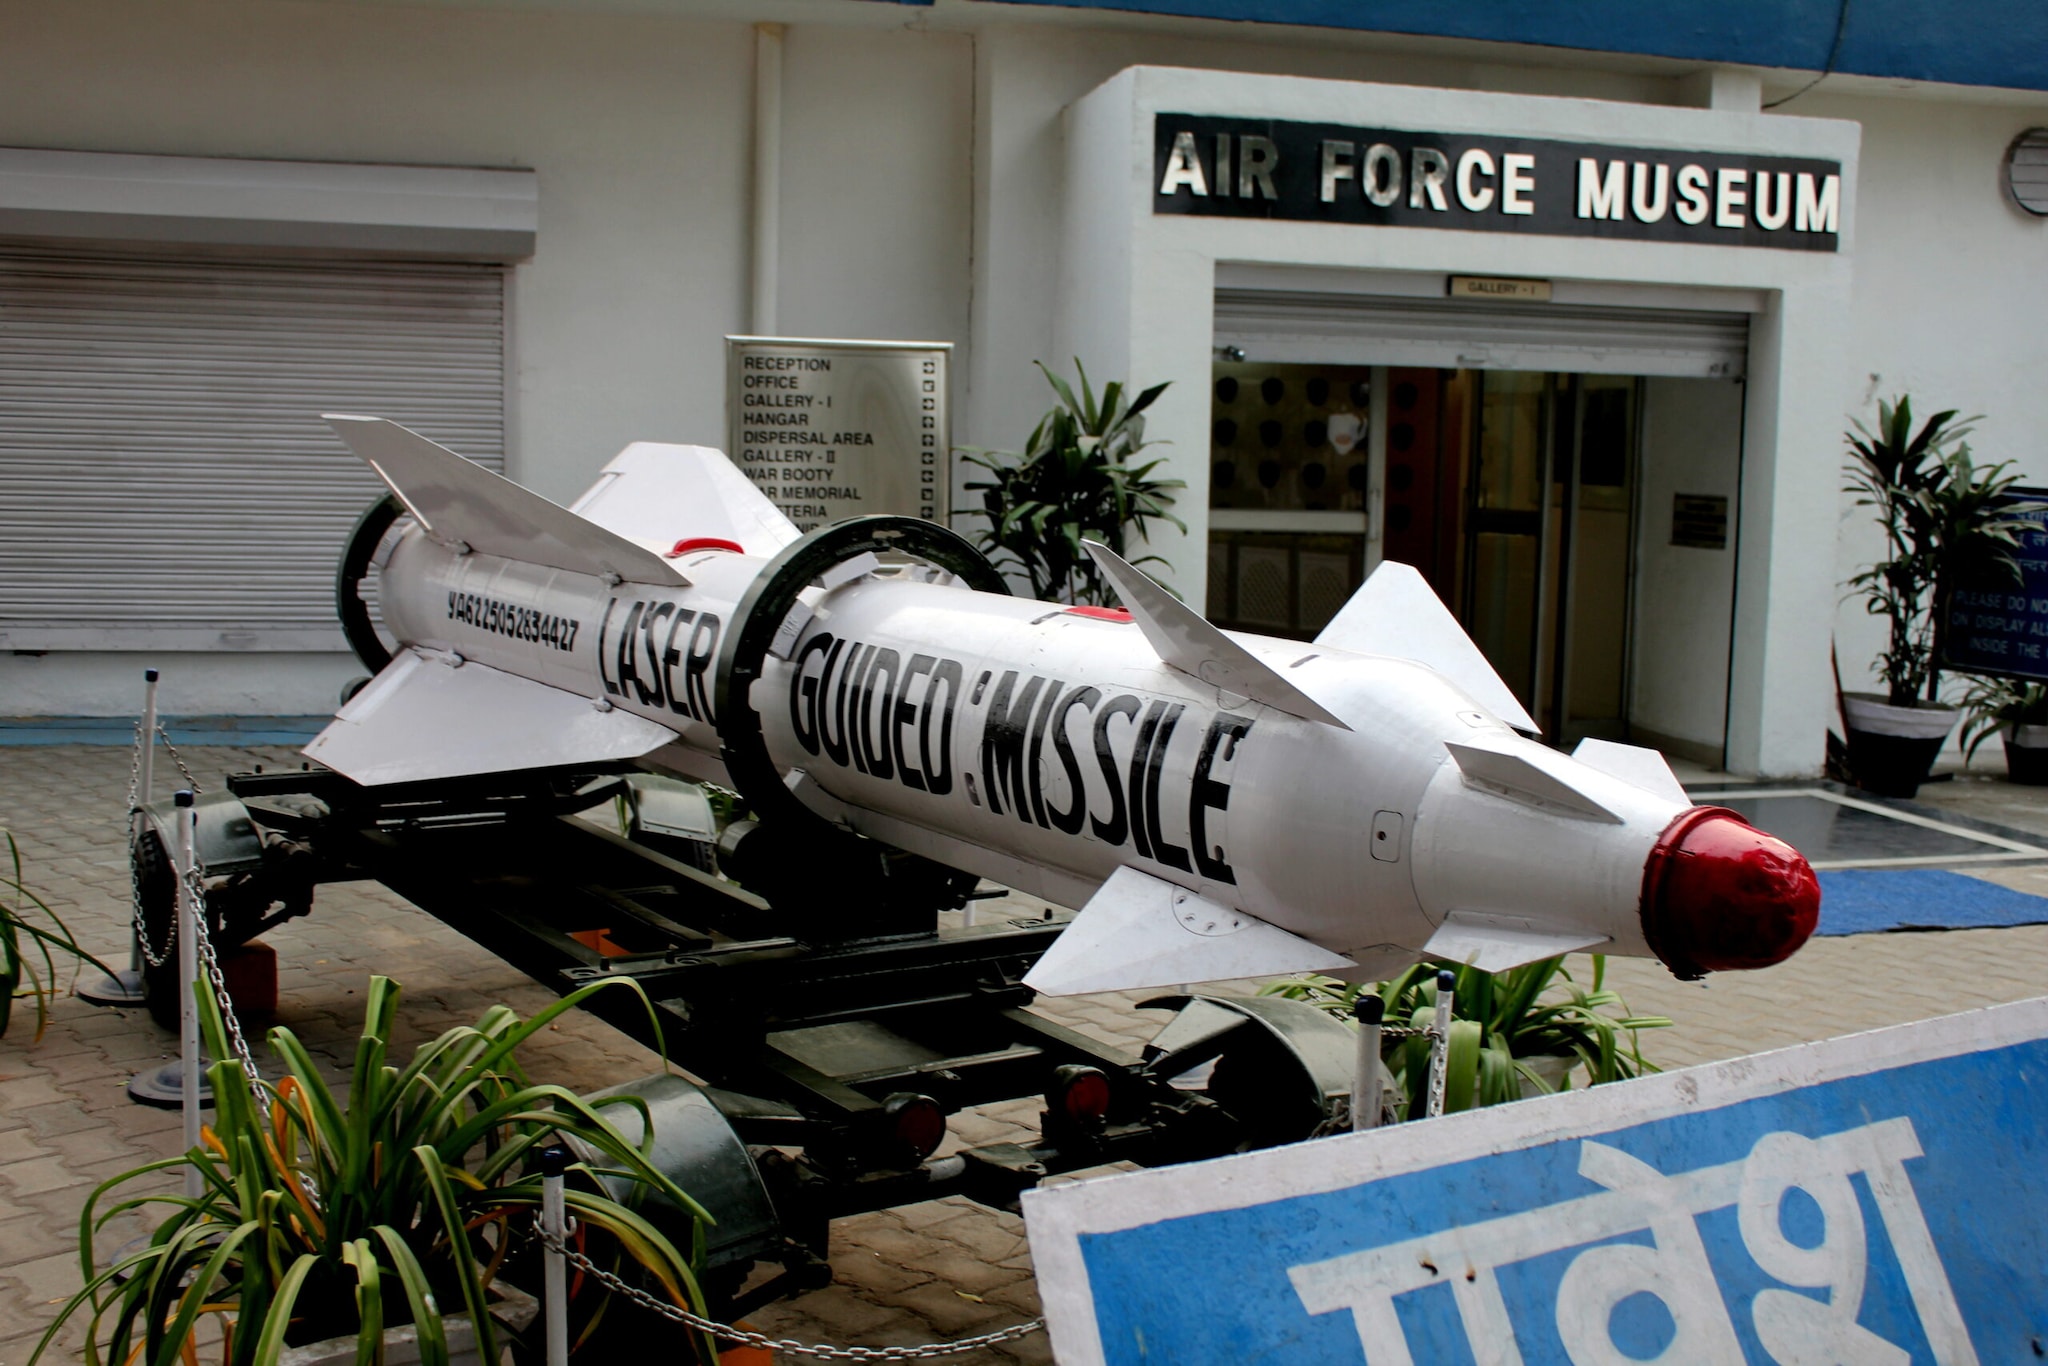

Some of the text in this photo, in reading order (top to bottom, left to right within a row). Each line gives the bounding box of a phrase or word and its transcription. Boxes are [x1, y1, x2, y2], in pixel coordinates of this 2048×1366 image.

[1160, 130, 1840, 234] AIR FORCE MUSEUM
[1468, 281, 1518, 294] GALLERY
[744, 357, 831, 372] RECEPTION
[744, 375, 798, 389] OFFICE
[744, 394, 813, 408] GALLERY
[744, 412, 809, 426] HANGAR
[743, 431, 874, 446] DISPERSAL AREA
[743, 450, 813, 463] GALLERY
[783, 469, 834, 482] BOOTY
[782, 486, 862, 500] MEMORIAL
[1954, 590, 2002, 609] PLEASE
[2007, 595, 2027, 612] DO
[1952, 611, 1969, 626] ON
[1975, 614, 2027, 633] DISPLAY
[1968, 637, 2041, 659] INSIDE THE
[599, 597, 1255, 886] LASER GUIDED MISSILE
